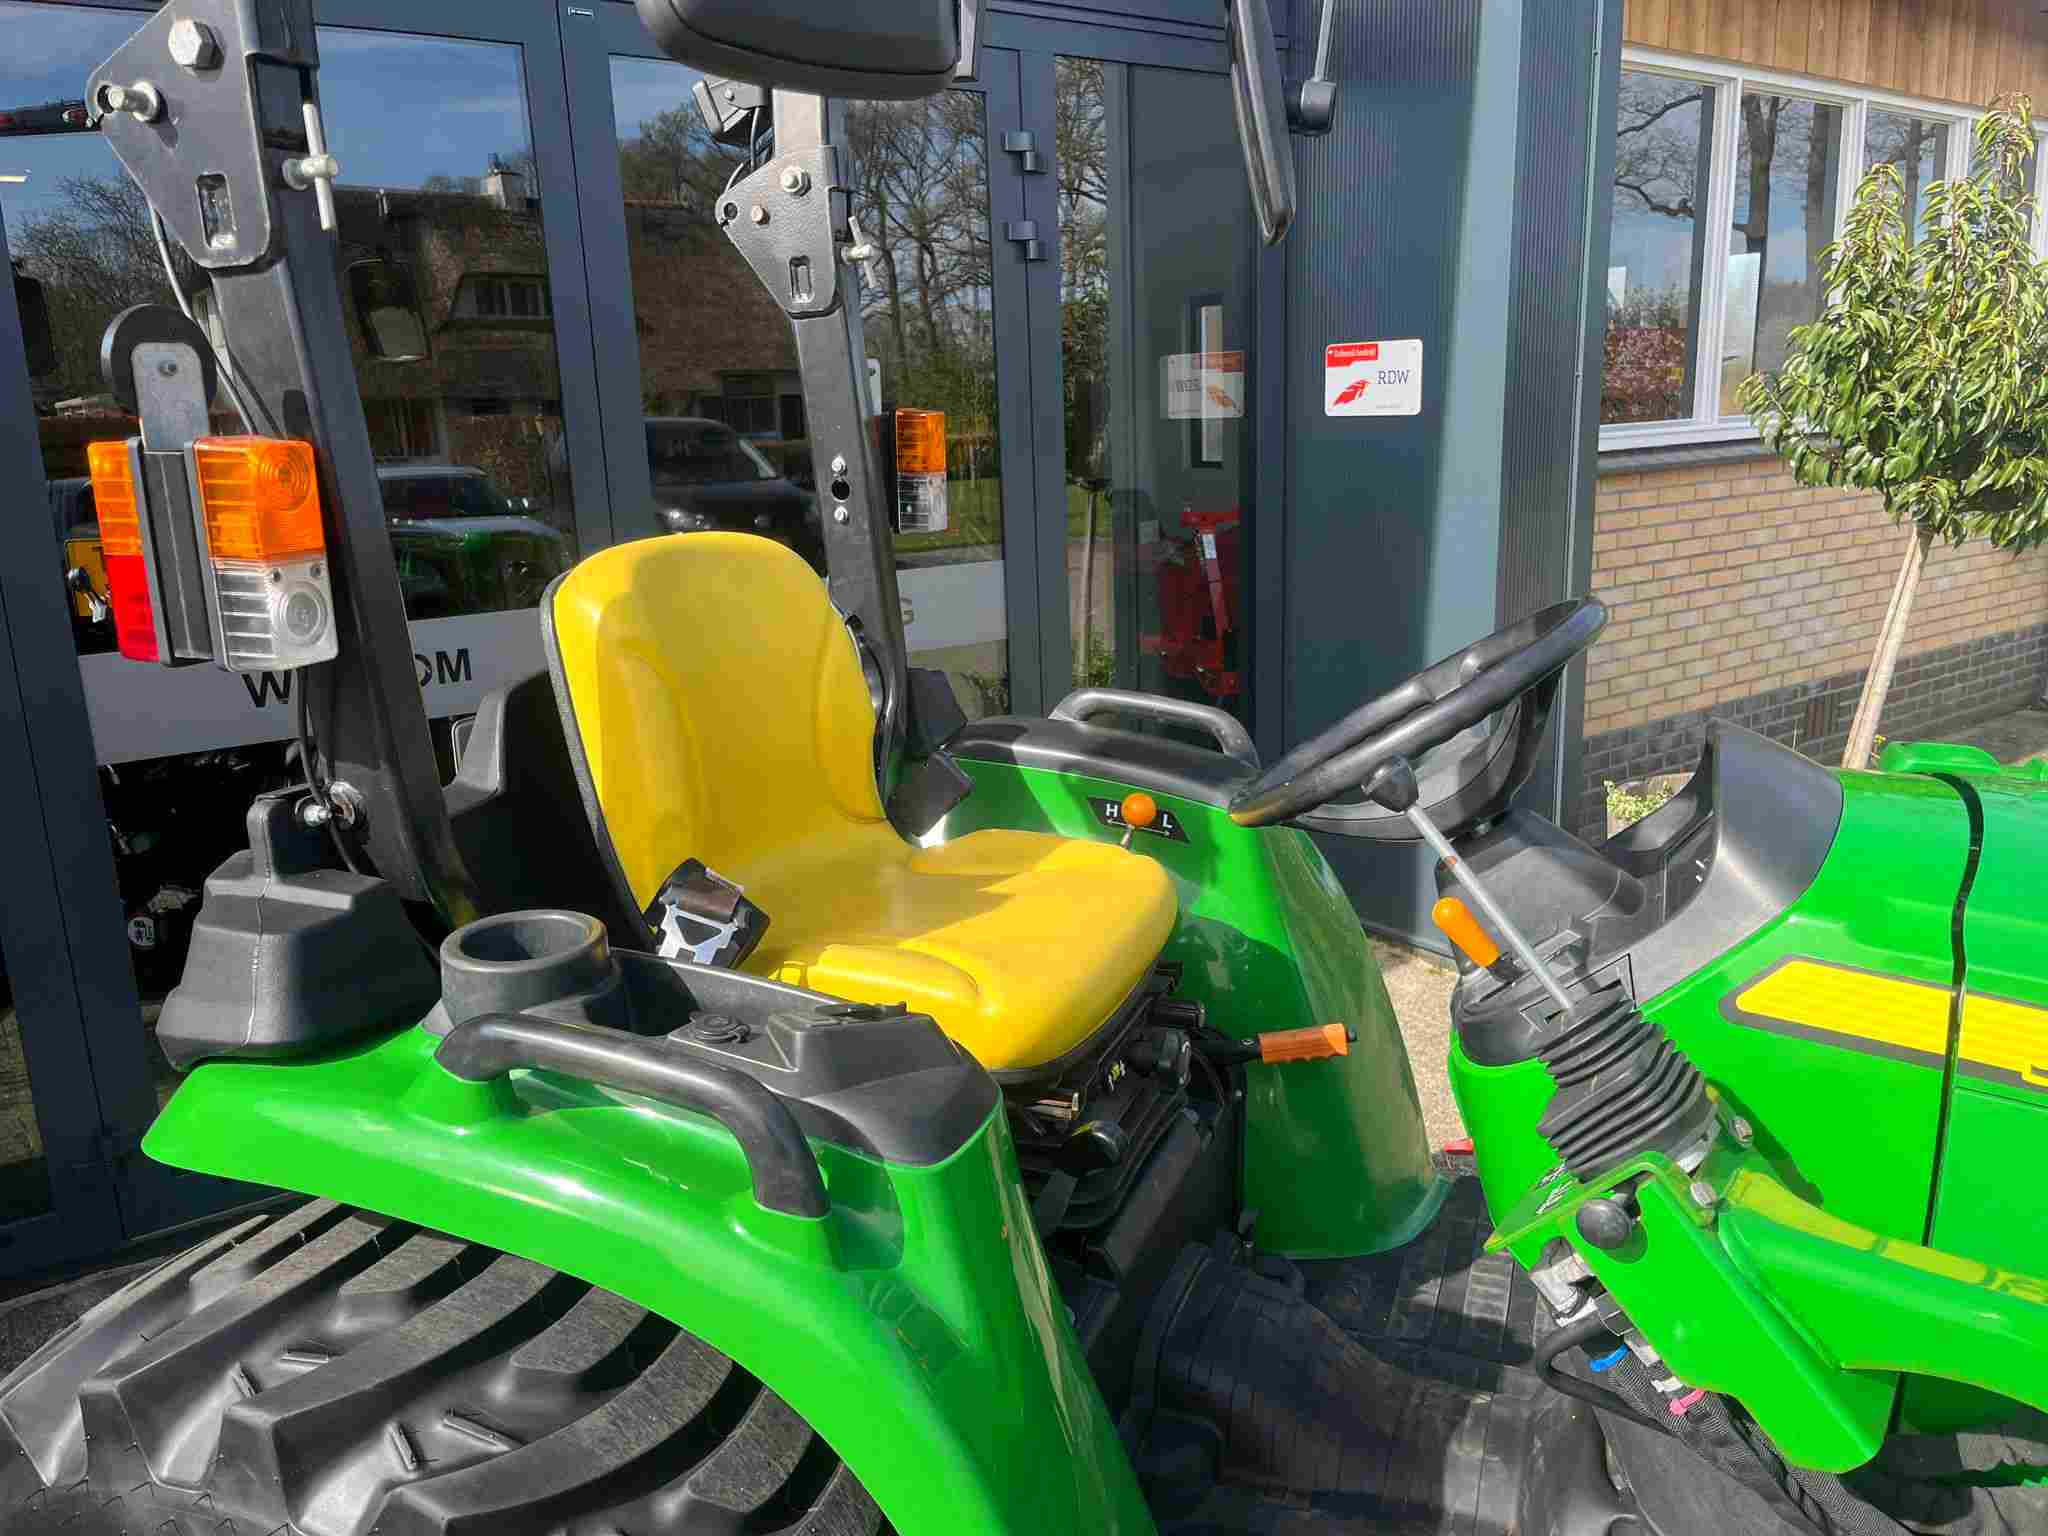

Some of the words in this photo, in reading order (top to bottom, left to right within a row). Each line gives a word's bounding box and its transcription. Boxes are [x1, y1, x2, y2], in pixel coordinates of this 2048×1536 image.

[1377, 369, 1411, 385] RDW
[1105, 803, 1119, 817] H
[1162, 813, 1173, 828] L
